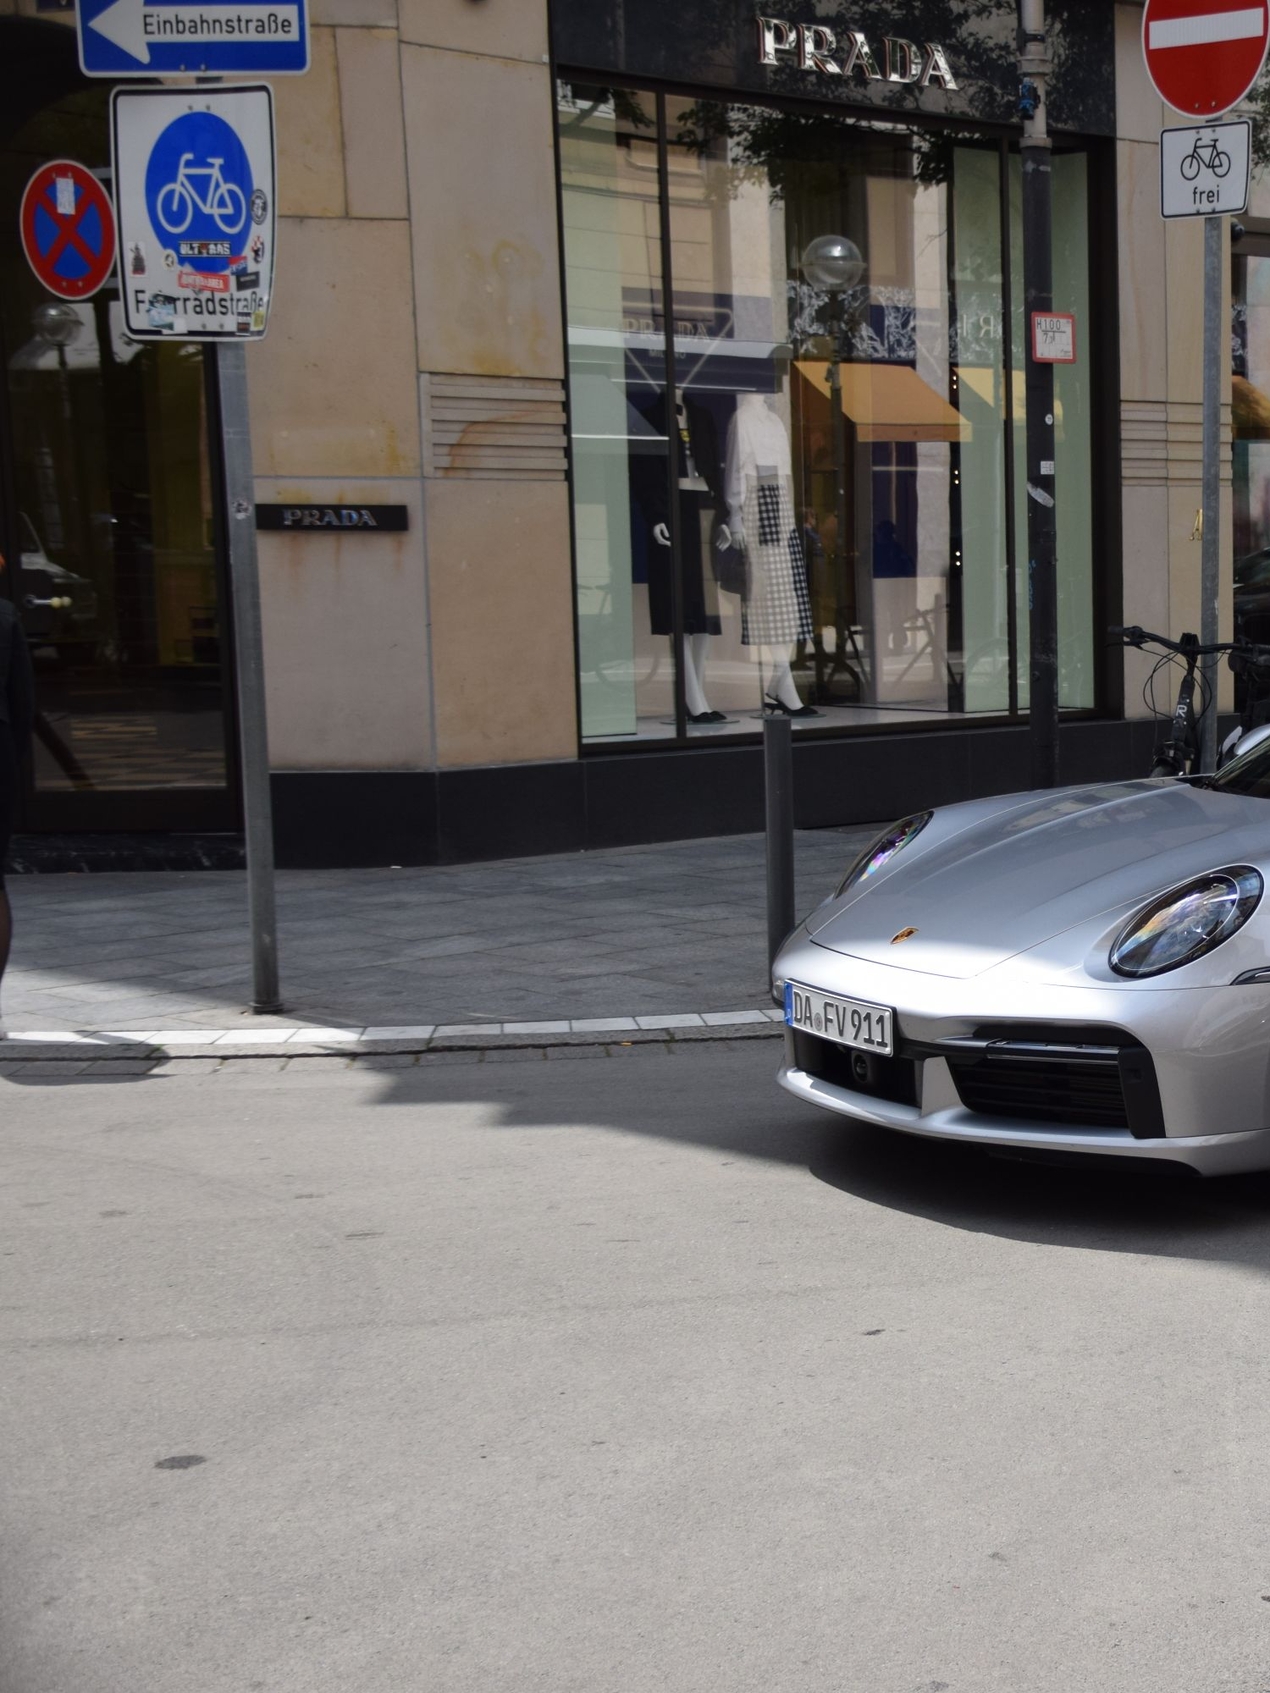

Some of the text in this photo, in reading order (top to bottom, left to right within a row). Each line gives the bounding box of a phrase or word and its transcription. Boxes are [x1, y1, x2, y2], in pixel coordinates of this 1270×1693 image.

[143, 13, 292, 35] Einbahnstraße
[757, 16, 959, 90] PRADA
[1192, 184, 1220, 205] frei
[133, 288, 264, 317] Frradstraße
[283, 509, 378, 526] PRADA
[793, 990, 888, 1048] DA FV 911
